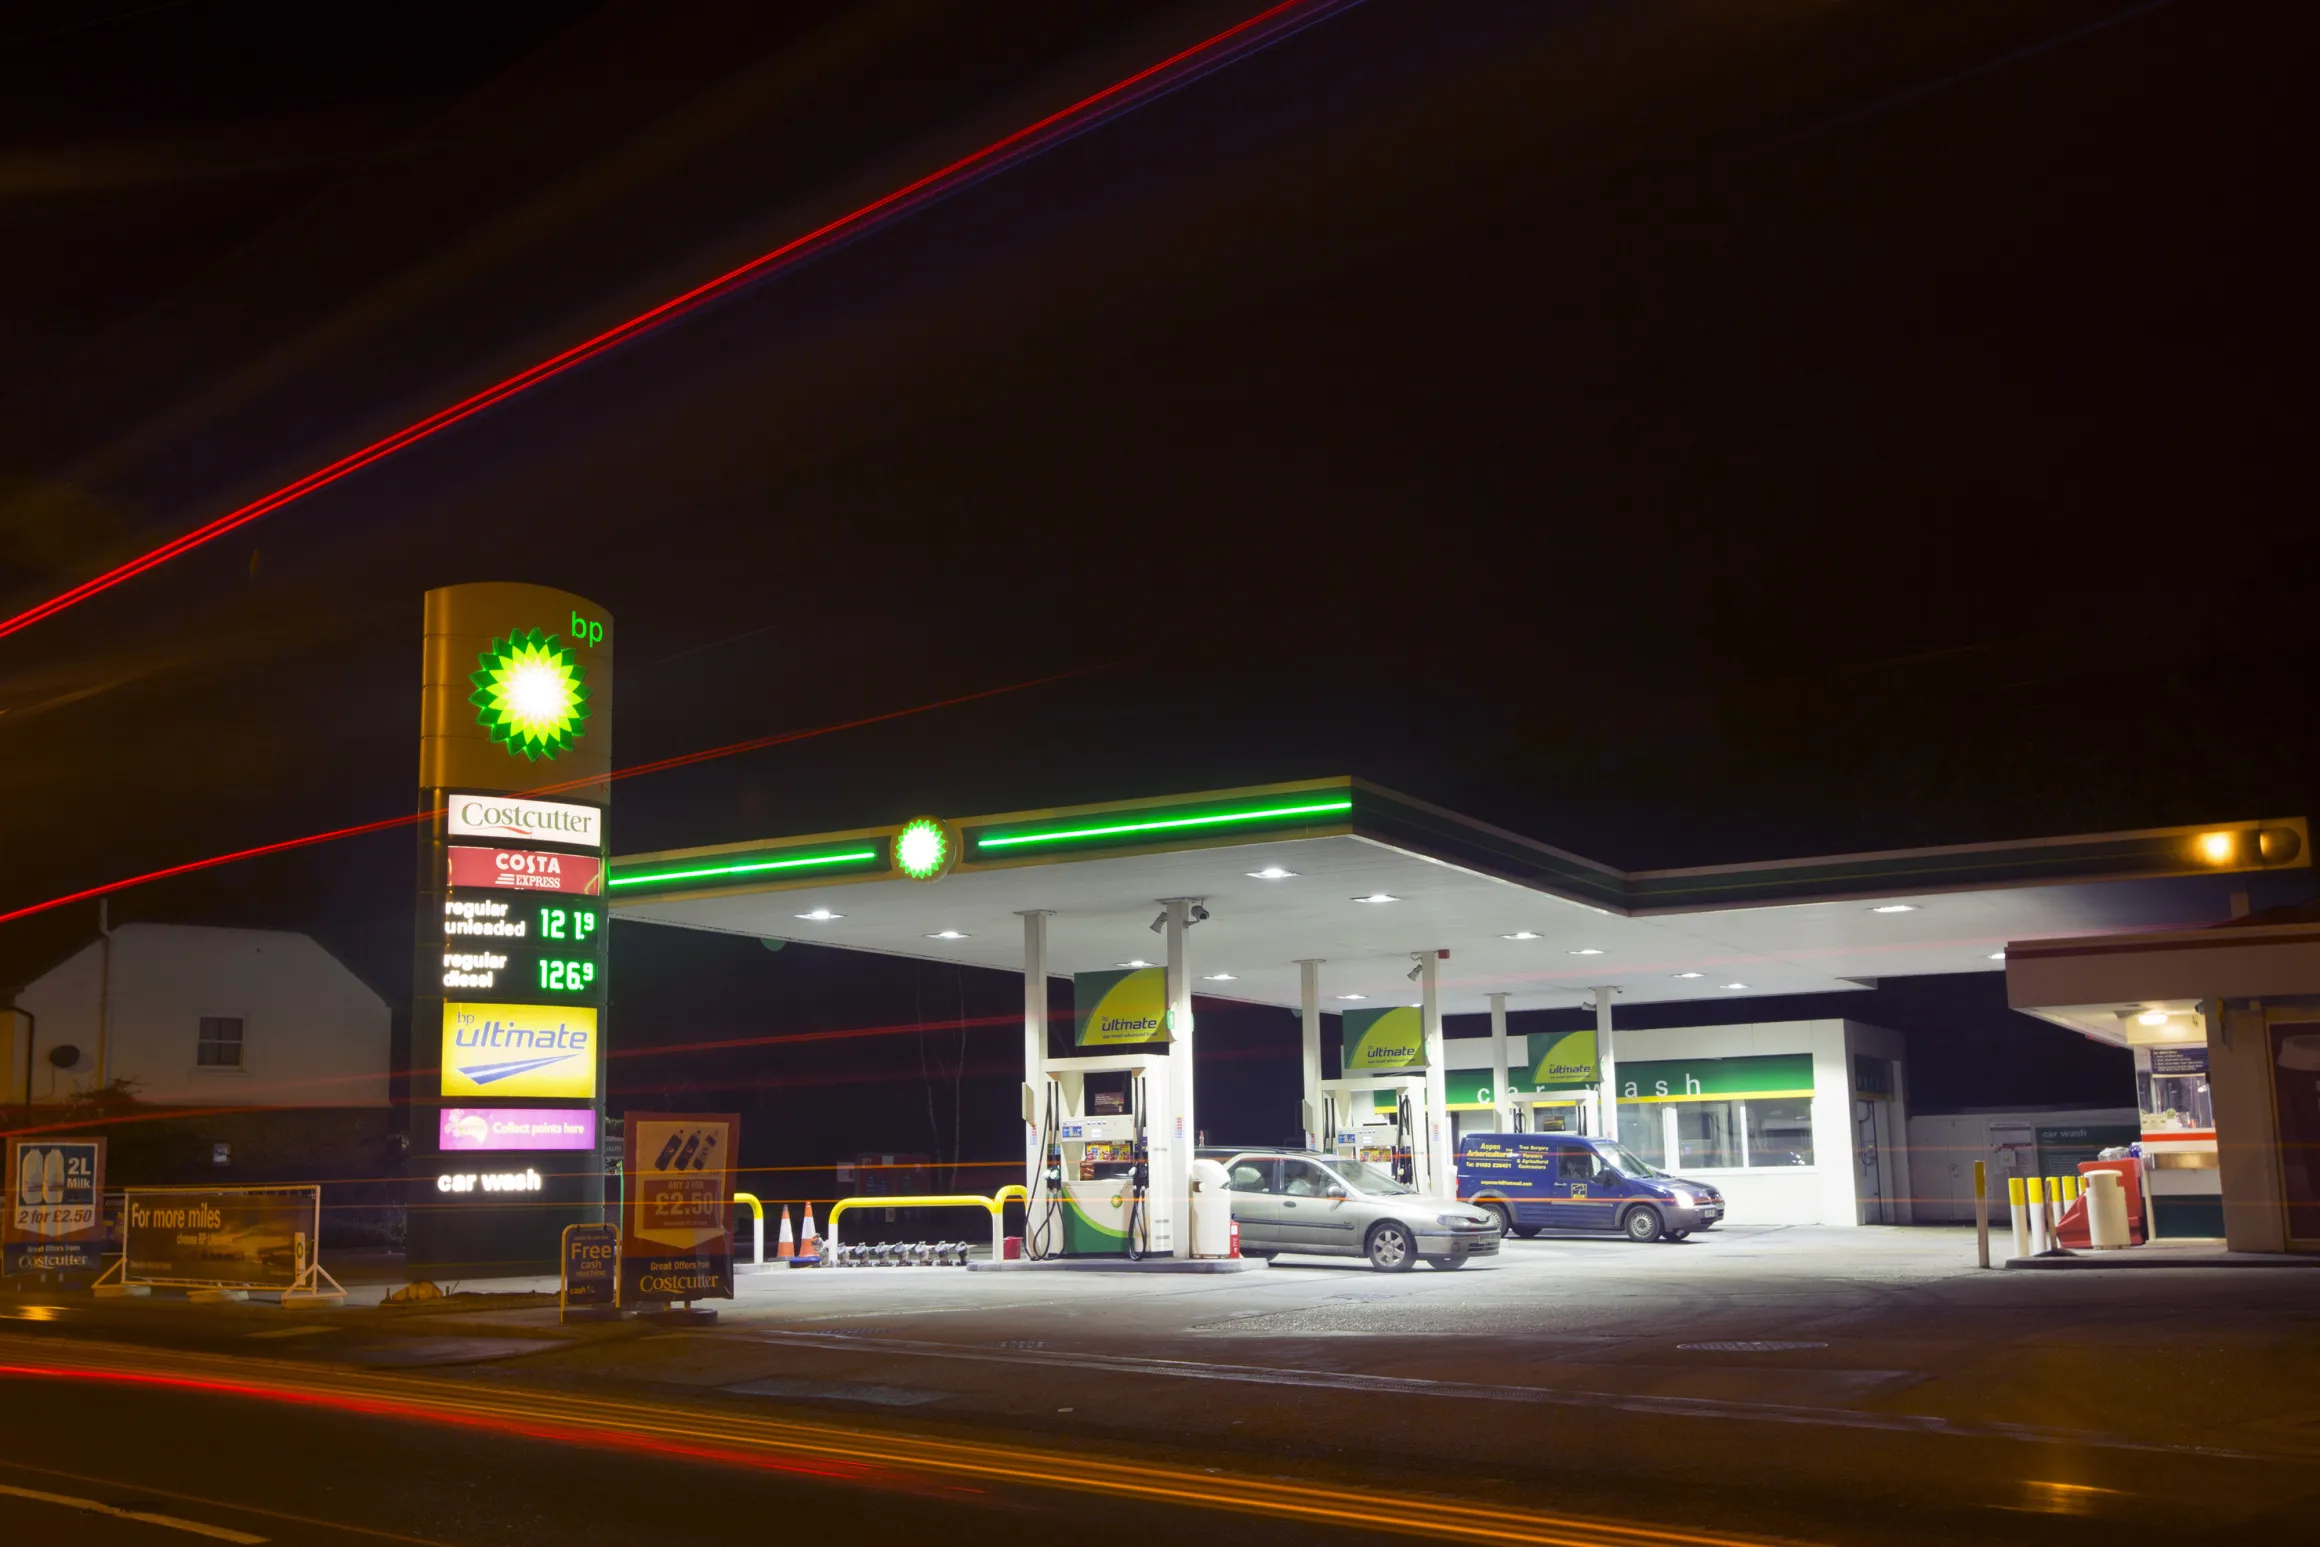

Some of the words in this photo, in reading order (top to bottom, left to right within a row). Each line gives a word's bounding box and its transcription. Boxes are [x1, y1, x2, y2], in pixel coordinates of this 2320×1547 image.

[571, 611, 603, 648] bp
[461, 802, 592, 834] Costcutter
[495, 853, 561, 874] COSTA
[515, 875, 561, 889] EXPRESS
[445, 899, 509, 918] regular
[444, 919, 526, 937] unleaded
[443, 952, 508, 971] regular
[443, 970, 494, 988] diesel
[457, 1011, 475, 1026] bp
[1101, 1017, 1157, 1032] ultimate
[456, 1021, 588, 1049] ultimate
[1367, 1046, 1415, 1058] ultimate
[1549, 1064, 1591, 1075] ultimate
[492, 1121, 530, 1134] Collect
[531, 1121, 562, 1136] points
[563, 1120, 585, 1134] here
[68, 1157, 91, 1175] 2L
[67, 1178, 91, 1189] Milk
[437, 1173, 477, 1192] car
[481, 1168, 542, 1192] wash
[685, 1180, 690, 1190] 2
[655, 1191, 714, 1216] £2.50
[18, 1210, 29, 1224] 2
[31, 1210, 51, 1224] for
[52, 1209, 92, 1223] £2.50
[131, 1202, 151, 1228] For
[153, 1208, 185, 1229] more
[188, 1202, 221, 1229] miles
[176, 1232, 198, 1246] choose
[571, 1242, 612, 1260] Free
[18, 1254, 88, 1269] Costcutter
[581, 1260, 602, 1269] cash
[650, 1261, 672, 1271] Great
[673, 1260, 697, 1270] Offers
[639, 1273, 719, 1292] Costcutter
